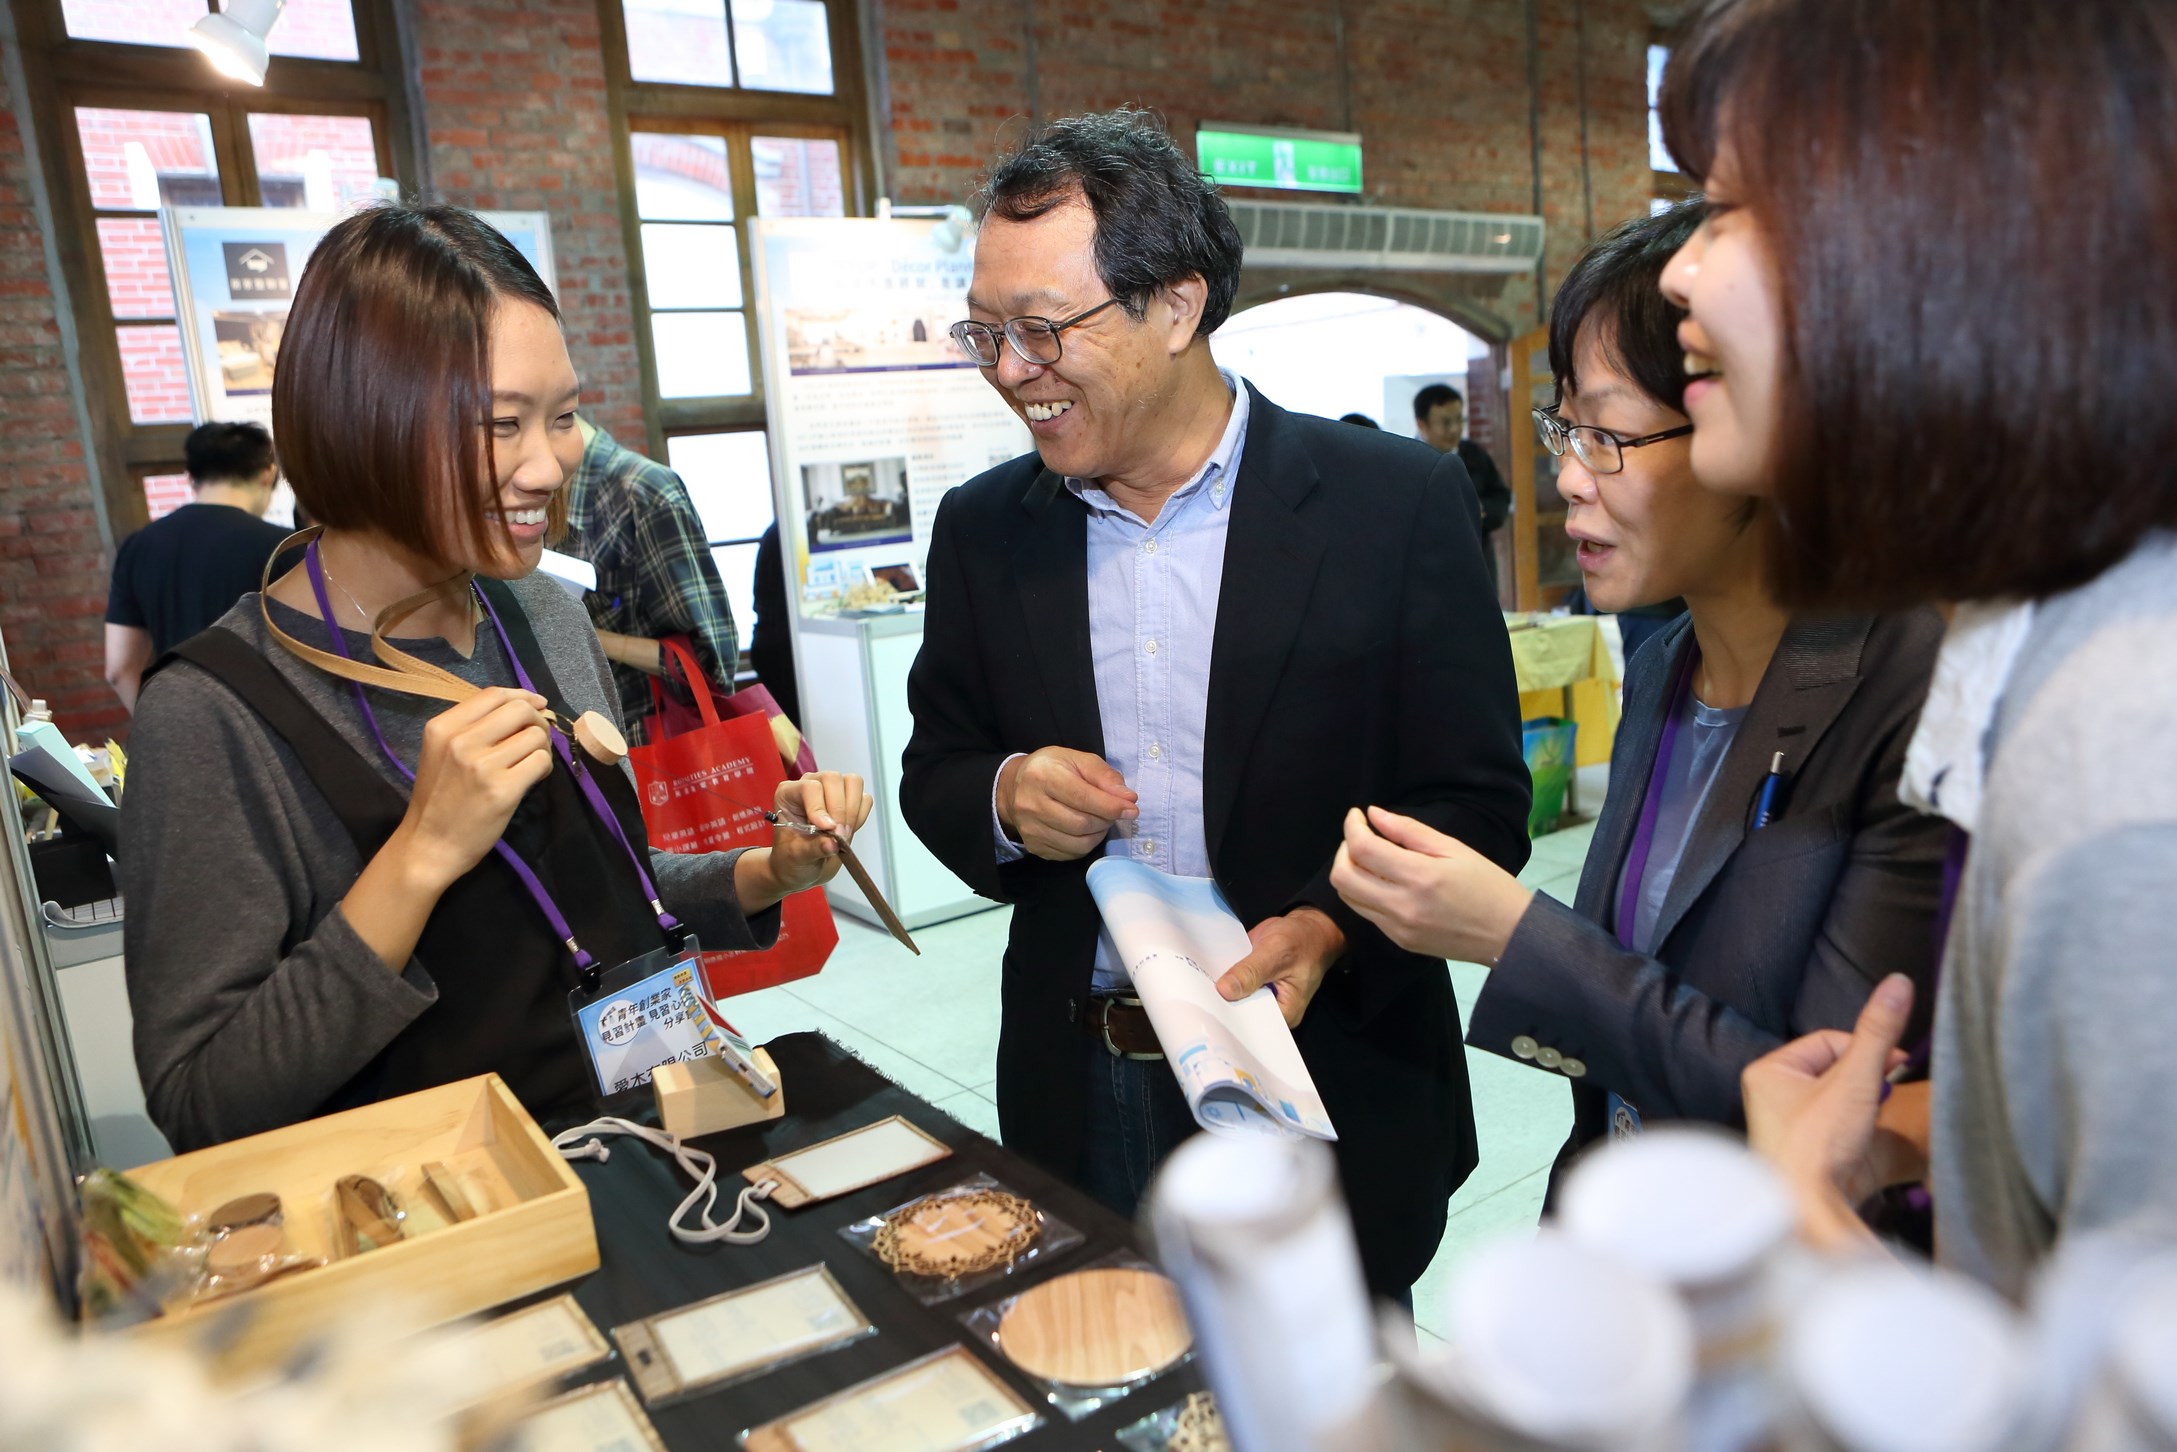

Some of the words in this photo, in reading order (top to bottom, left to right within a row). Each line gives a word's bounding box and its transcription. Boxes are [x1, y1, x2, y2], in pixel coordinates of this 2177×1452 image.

[711, 757, 751, 773] ACADEMY
[617, 987, 672, 1022] 青年創業家
[601, 1014, 648, 1043] 見習計畫
